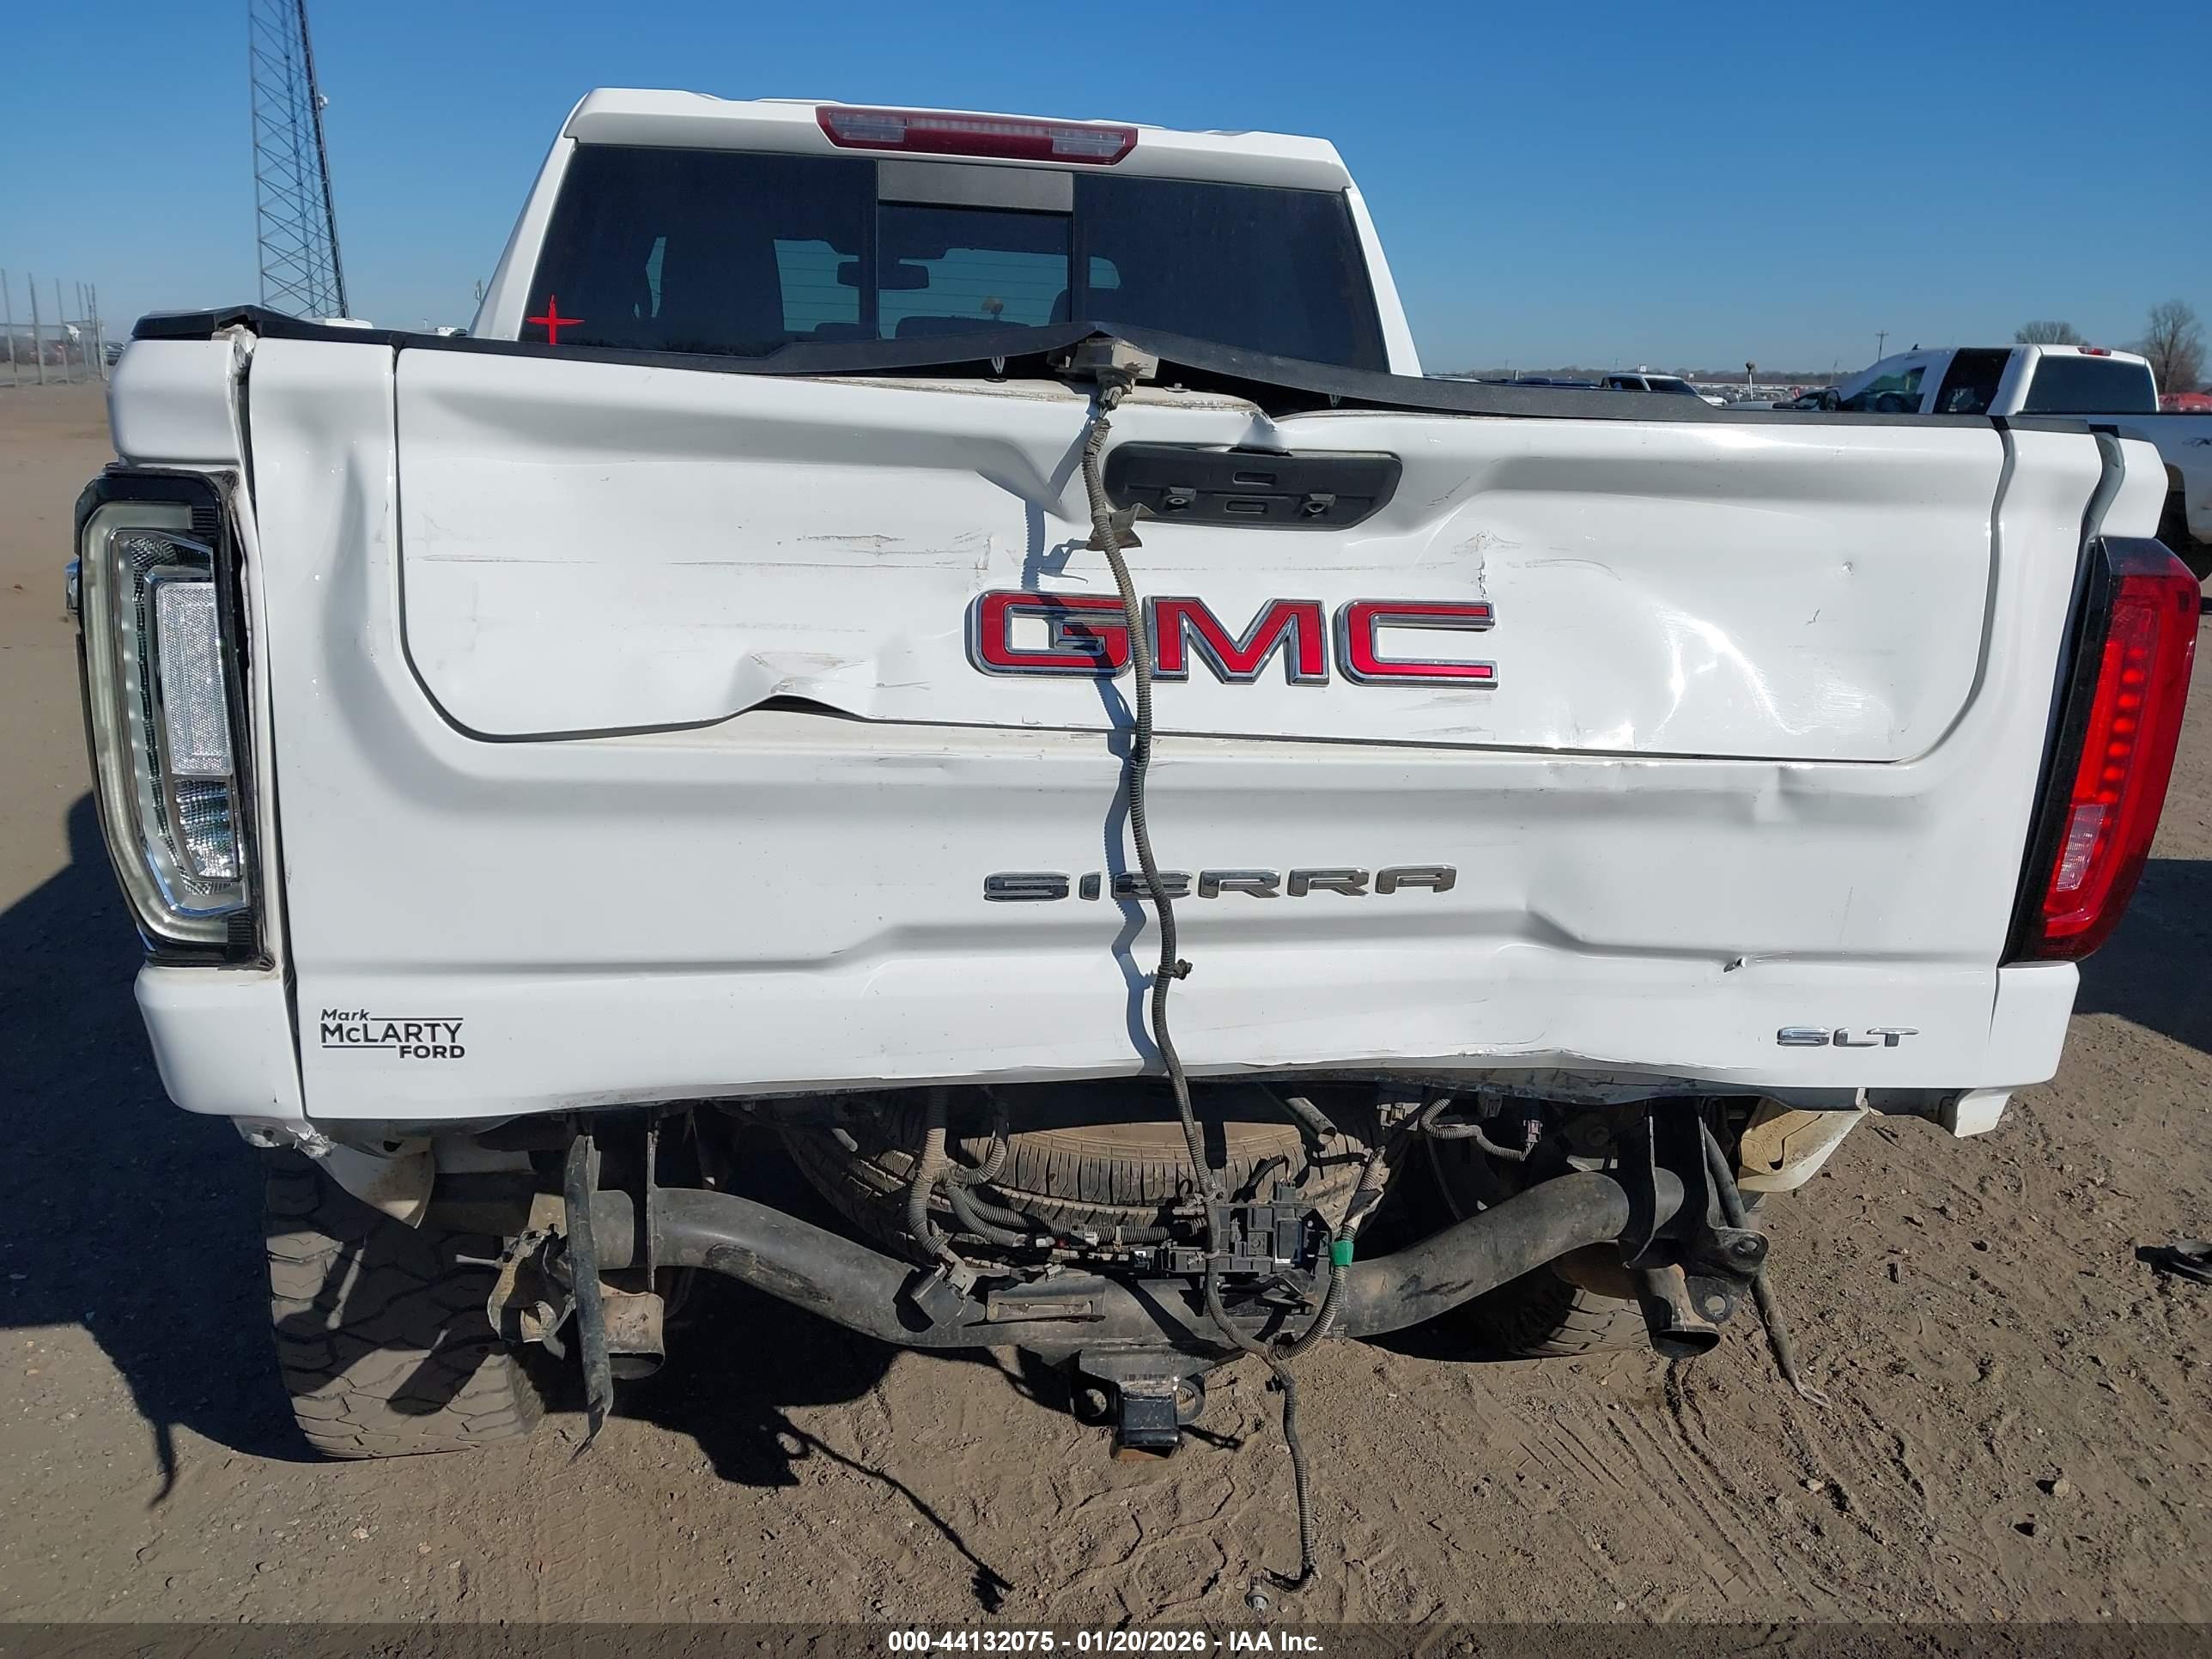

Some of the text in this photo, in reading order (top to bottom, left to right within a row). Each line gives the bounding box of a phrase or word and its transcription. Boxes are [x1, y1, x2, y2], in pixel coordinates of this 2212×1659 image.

[967, 589, 1498, 690] GMC
[983, 864, 1457, 902] SIERRA
[320, 1008, 371, 1022] Mark
[320, 1023, 463, 1043] McLARTY
[1777, 1026, 1919, 1048] SLT
[398, 1044, 465, 1059] FORD
